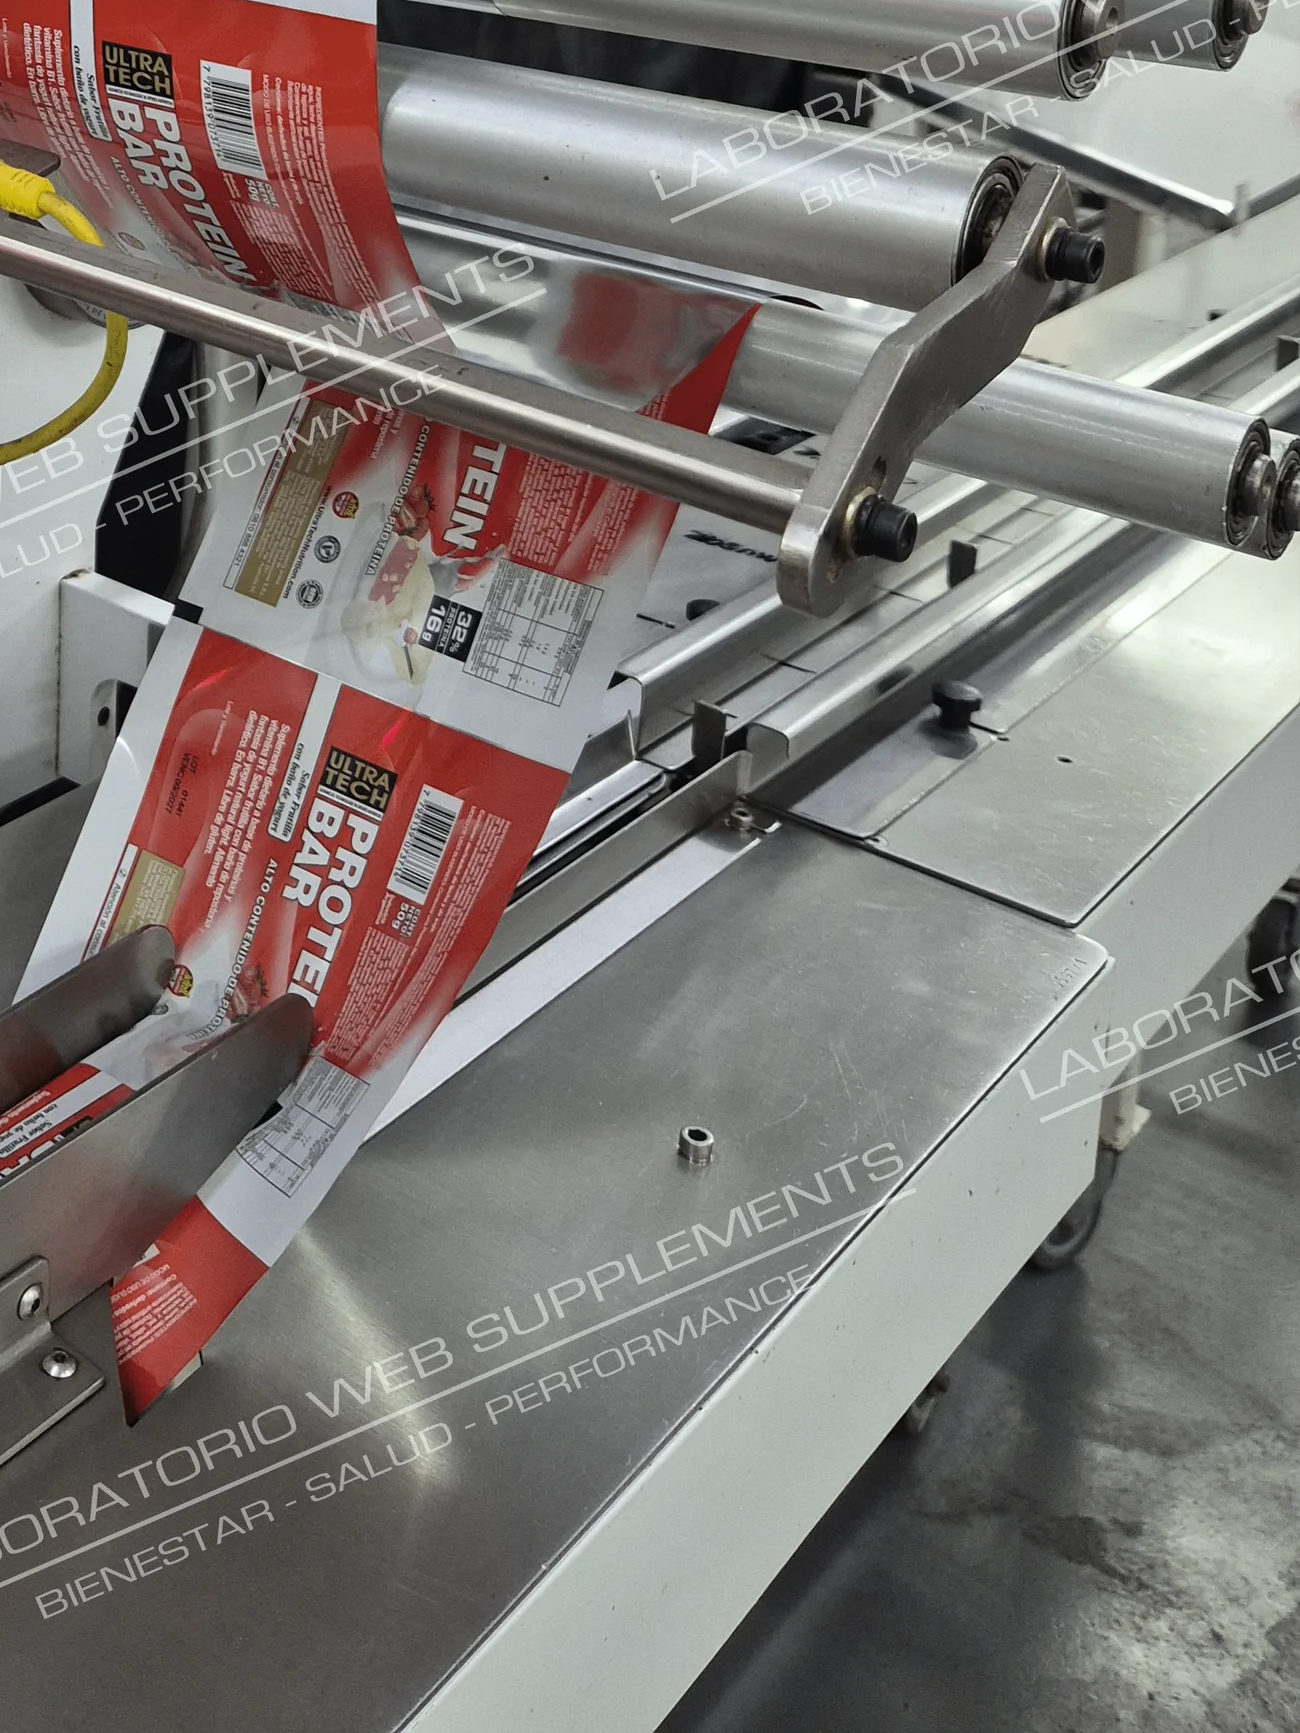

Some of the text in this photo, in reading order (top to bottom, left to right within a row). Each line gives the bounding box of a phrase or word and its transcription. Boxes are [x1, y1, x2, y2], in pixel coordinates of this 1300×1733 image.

[104, 44, 171, 77] ULTRA
[105, 64, 171, 97] TECH
[107, 97, 170, 191] BAR
[144, 106, 259, 283] PROTEIN
[363, 424, 432, 577] CONTENIDO DE PROTEINA
[281, 483, 334, 601] www.UltraTechNutrition.com
[436, 605, 457, 648] PROTEINA
[320, 766, 389, 810] TECH
[326, 749, 393, 791] ULTRA
[279, 796, 346, 908] BAR
[257, 857, 279, 893] ALTO
[227, 895, 265, 973] CONTENIDO
[389, 901, 410, 929] 50g
[222, 974, 239, 996] DE
